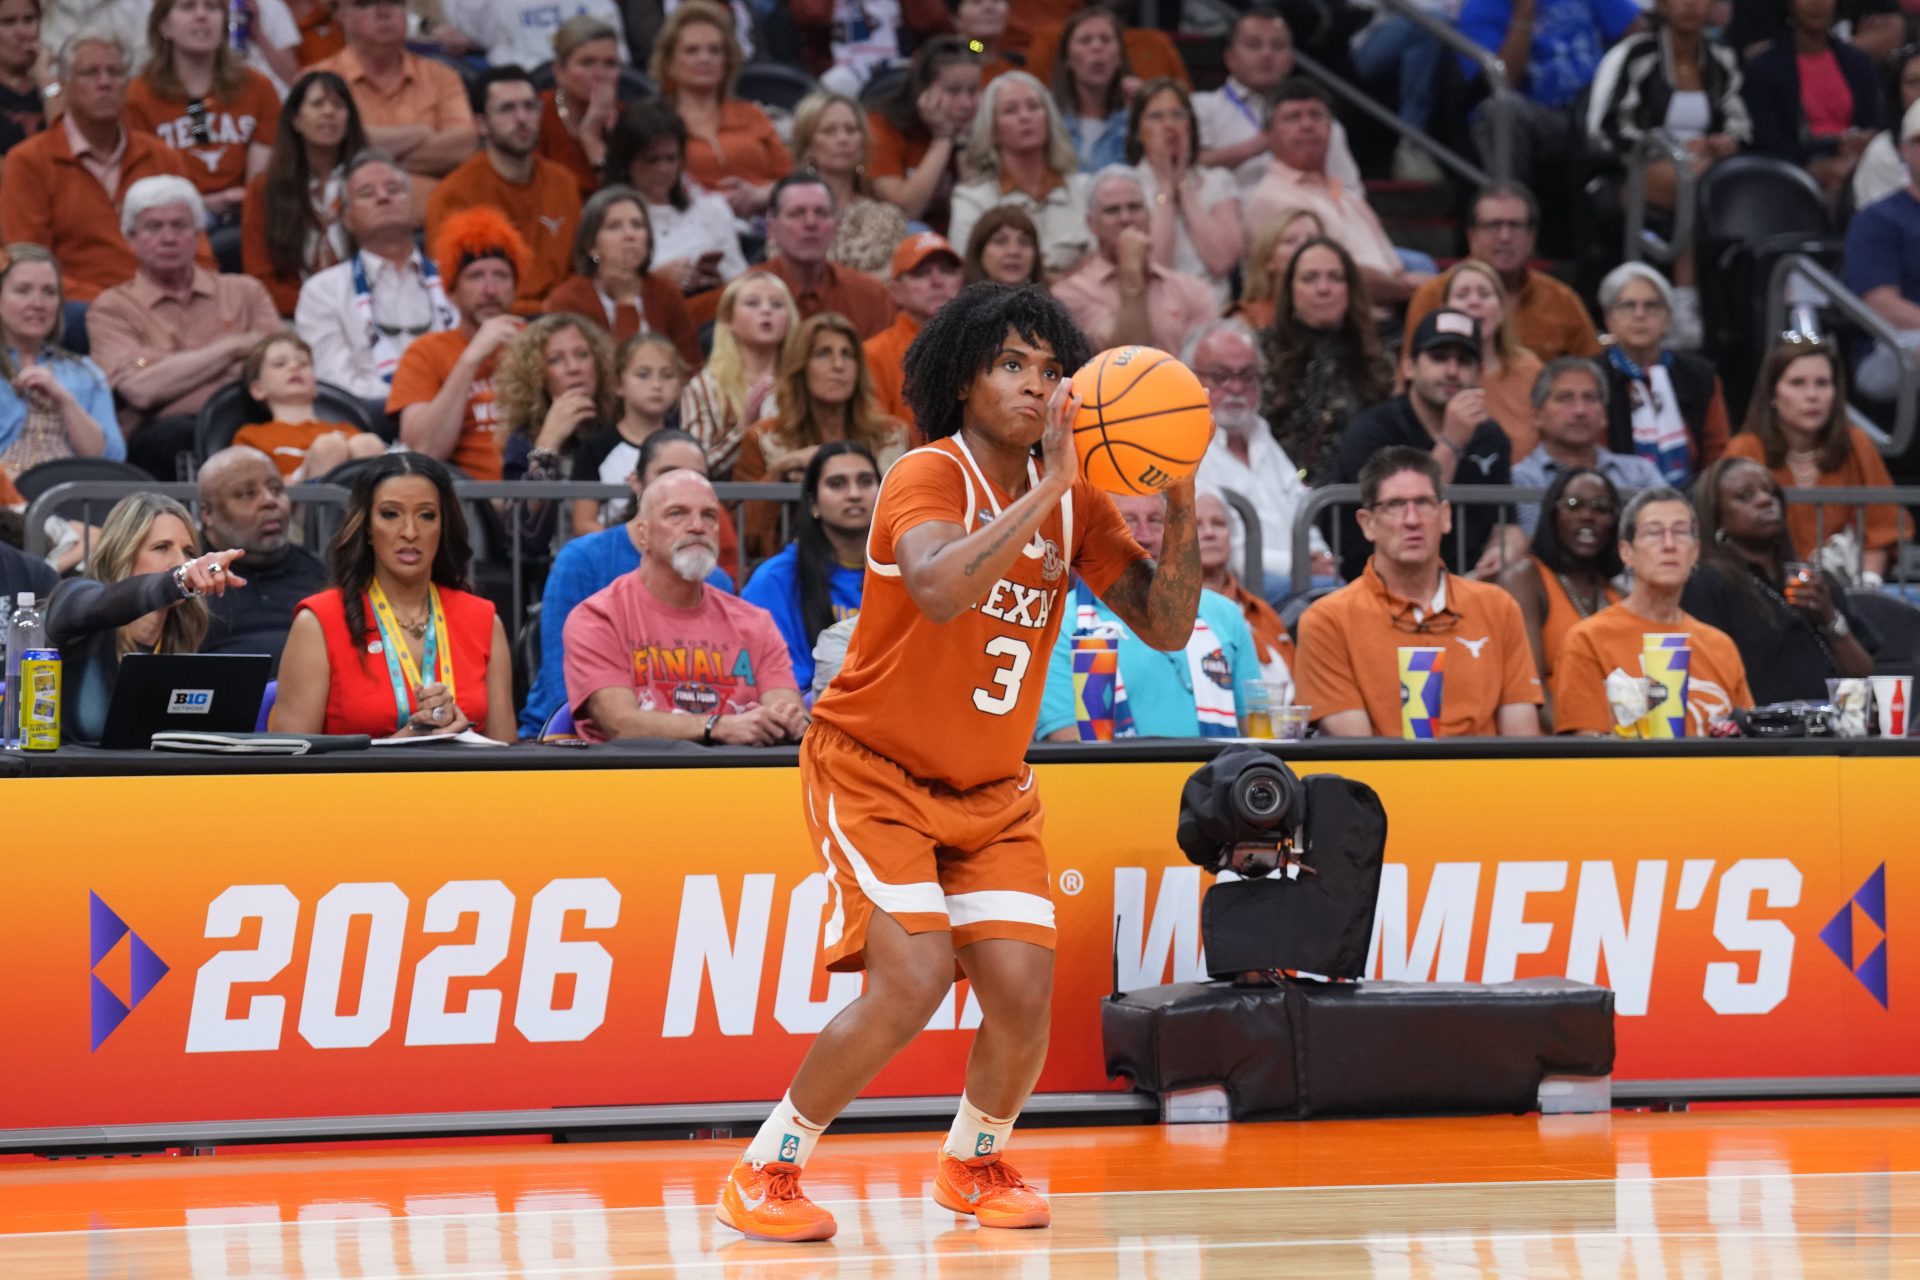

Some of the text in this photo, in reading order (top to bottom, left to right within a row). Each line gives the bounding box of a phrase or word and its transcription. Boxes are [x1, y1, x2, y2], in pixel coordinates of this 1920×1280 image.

[971, 578, 1058, 629] EXA
[633, 645, 755, 686] FINAL 4
[972, 635, 1032, 716] 3
[675, 690, 717, 704] FINAL FOUR
[185, 877, 622, 1053] 2026
[1113, 858, 1803, 1016] WMEN'S
